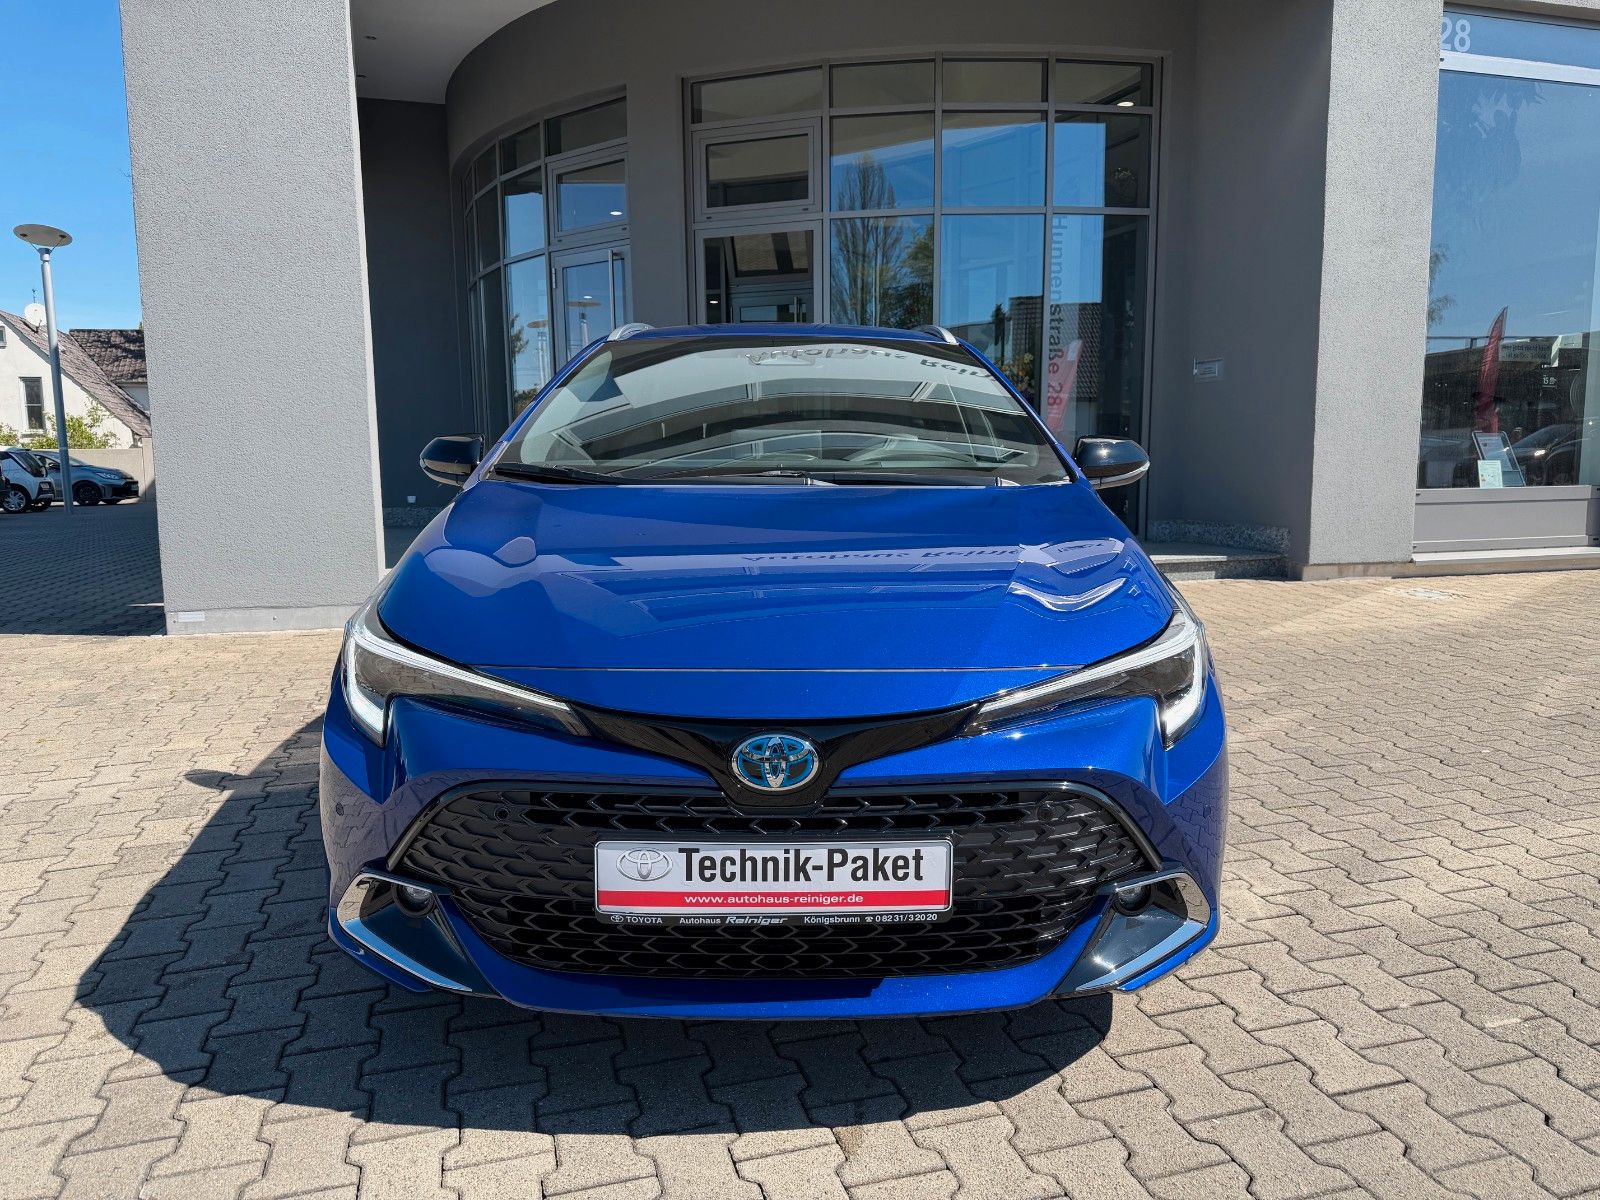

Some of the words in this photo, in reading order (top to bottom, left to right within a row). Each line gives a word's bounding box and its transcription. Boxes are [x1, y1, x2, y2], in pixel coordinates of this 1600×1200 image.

[1441, 16, 1471, 52] 28
[678, 847, 925, 883] Technik-Paket
[684, 893, 864, 905] www.autohaus-reiniger.de
[626, 916, 663, 925] TOYOTA
[679, 917, 721, 925] Autohaus
[725, 915, 789, 926] Reiniger
[804, 915, 861, 925] Königsbrunn
